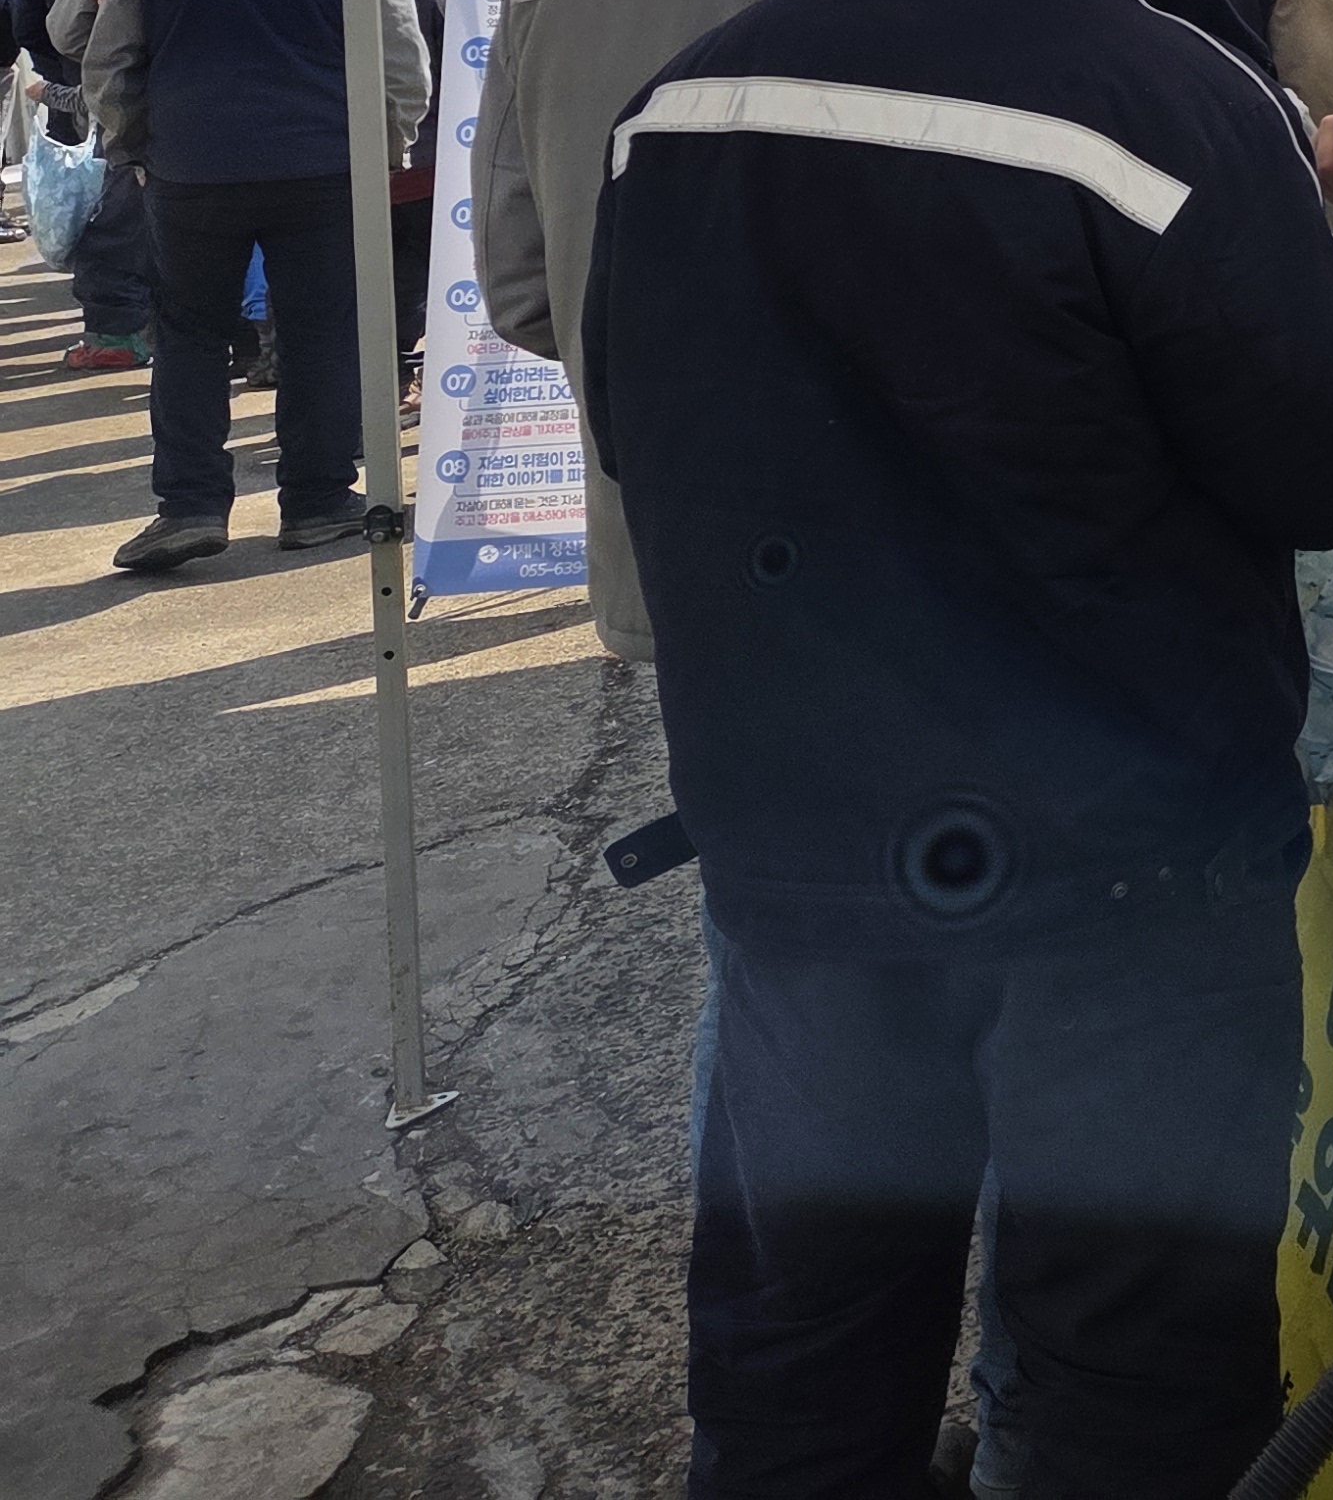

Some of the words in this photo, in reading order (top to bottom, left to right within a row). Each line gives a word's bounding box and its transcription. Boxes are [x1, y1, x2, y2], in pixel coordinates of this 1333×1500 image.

[466, 46, 490, 61] 03
[461, 126, 475, 142] 0
[456, 207, 472, 223] 0
[451, 288, 477, 306] 06
[446, 373, 472, 391] 07
[484, 366, 559, 385] 자살하려는
[441, 459, 466, 477] 08
[477, 454, 518, 470] 자살의
[522, 452, 563, 468] 위험이
[567, 450, 585, 465] 있
[477, 472, 504, 488] 대한
[507, 468, 563, 486] 이야기를
[567, 468, 585, 482] 피
[489, 498, 512, 510] 대해
